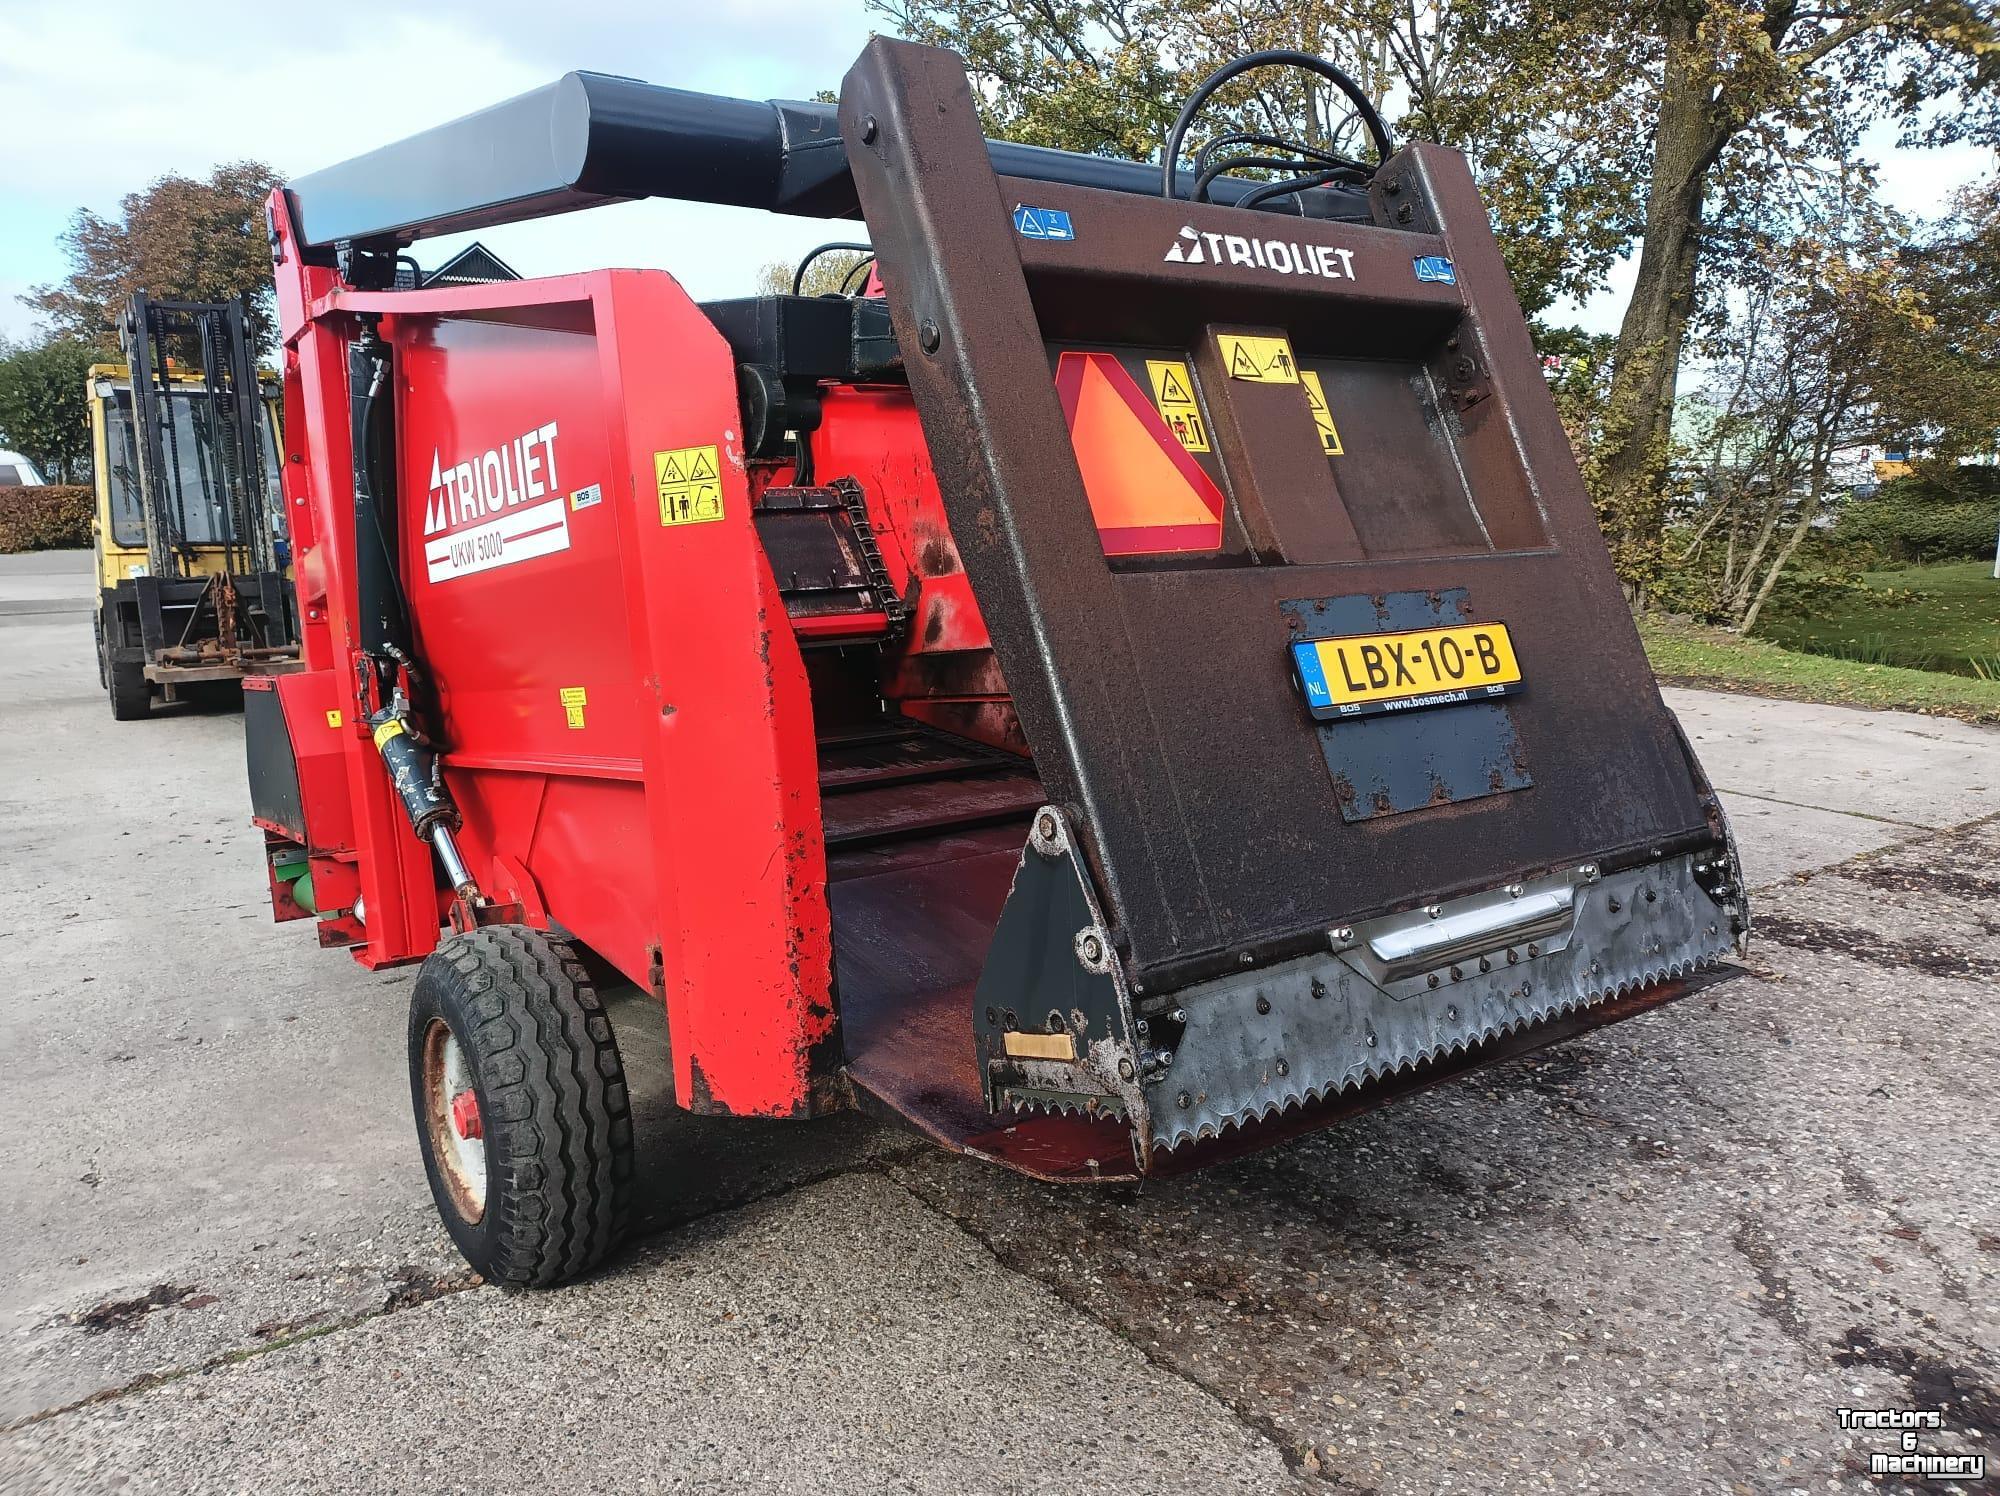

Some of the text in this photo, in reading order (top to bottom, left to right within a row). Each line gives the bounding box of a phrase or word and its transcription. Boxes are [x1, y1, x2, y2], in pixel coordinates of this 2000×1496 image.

[1200, 232, 1356, 282] TRIOLIET
[441, 421, 560, 526] TRIOLIET
[450, 531, 503, 569] UKW 5000
[1337, 633, 1501, 691] LBX-10-B
[1308, 681, 1327, 696] NL
[1384, 690, 1469, 712] www.bosmech.nl
[1485, 684, 1505, 694] BOS
[1340, 703, 1361, 713] BOS
